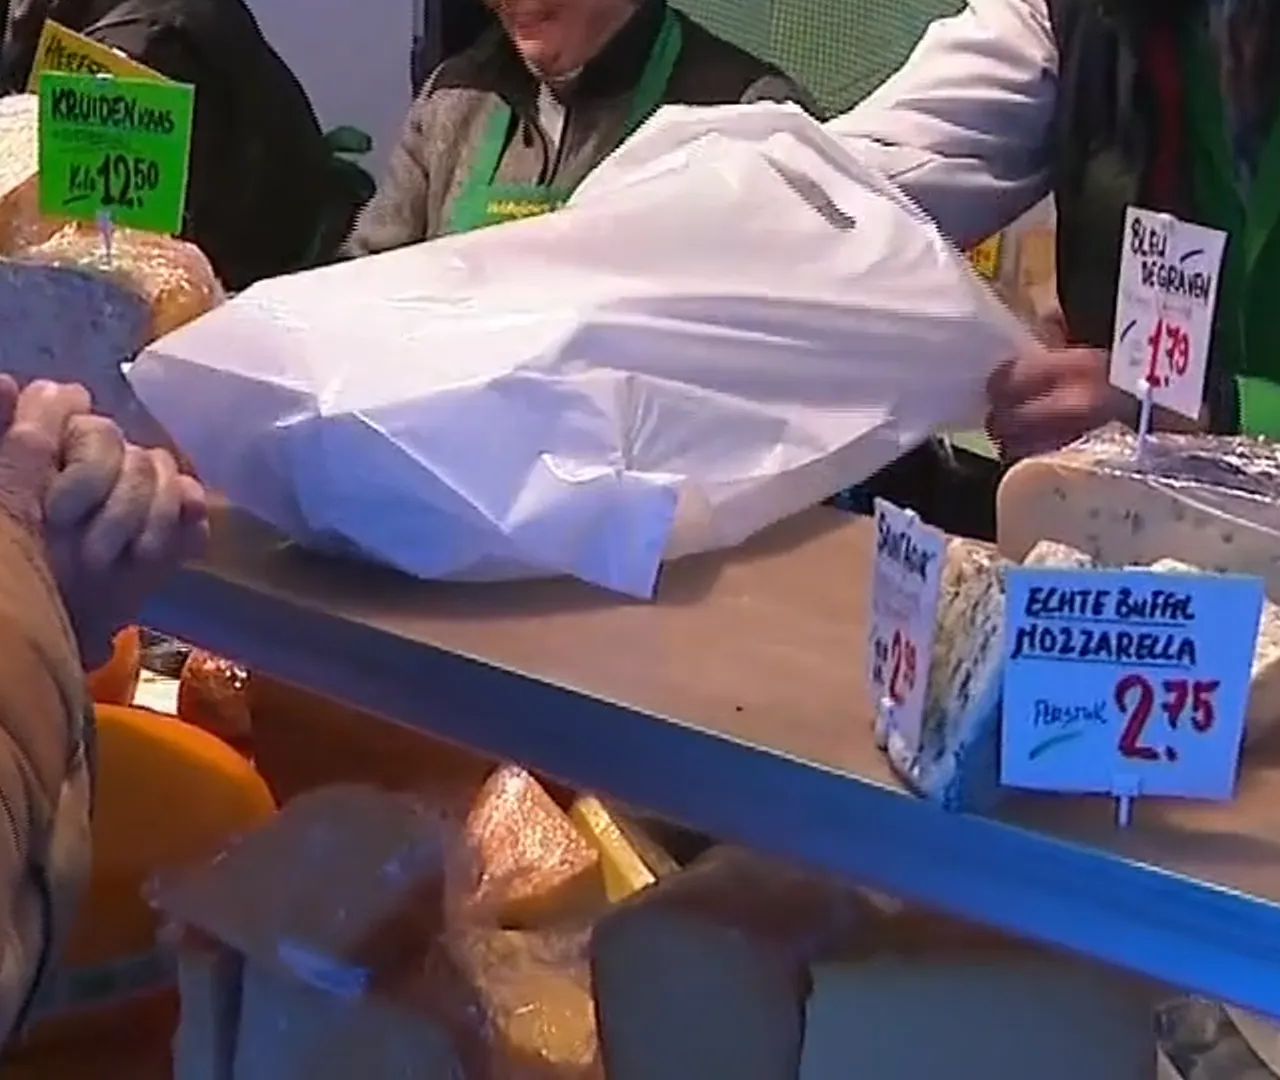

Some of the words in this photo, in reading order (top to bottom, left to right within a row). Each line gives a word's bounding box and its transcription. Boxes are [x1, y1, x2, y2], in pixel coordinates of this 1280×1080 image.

[1130, 217, 1168, 259] BLEU
[1025, 586, 1111, 617] ECHTE
[1010, 623, 1197, 666] MOZZARELLA
[1114, 673, 1221, 762] 2.75
